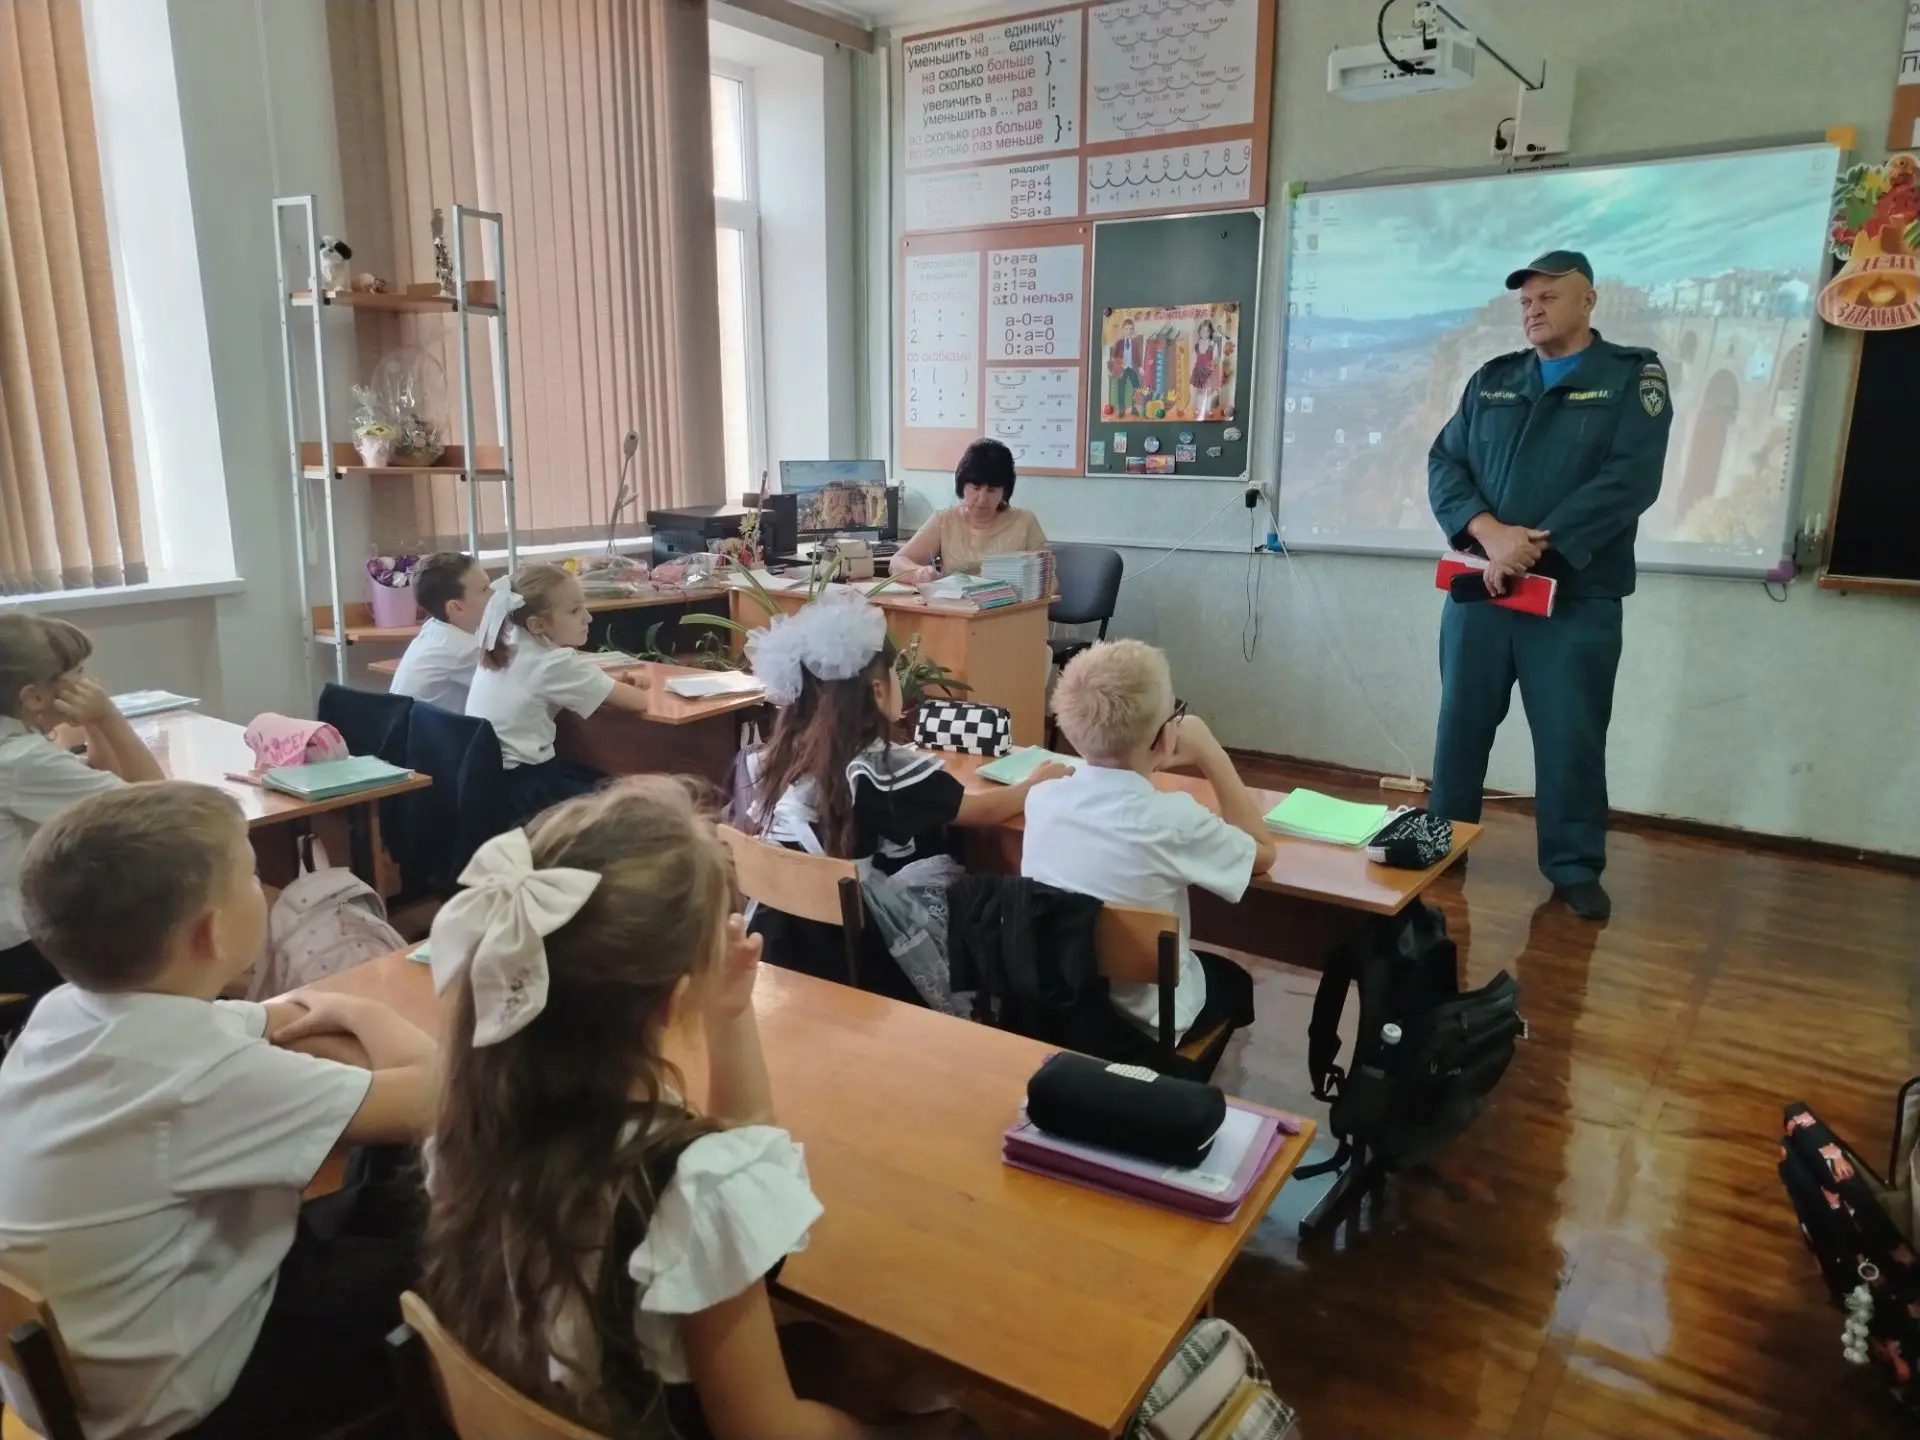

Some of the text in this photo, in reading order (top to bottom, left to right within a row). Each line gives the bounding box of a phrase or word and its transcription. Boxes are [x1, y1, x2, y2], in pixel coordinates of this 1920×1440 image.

[908, 36, 967, 57] увеличить
[970, 32, 984, 45] на
[908, 51, 971, 73] уменьшить
[975, 45, 989, 58] на
[922, 54, 1034, 83] на сколько больше
[922, 67, 1036, 96] на сколько меньше
[923, 95, 982, 114] увеличить
[985, 94, 992, 103] в
[1012, 86, 1033, 103] раз
[923, 108, 987, 129] уменьшить
[990, 106, 997, 116] в
[1017, 100, 1038, 116] раз
[924, 128, 970, 145] сколько
[972, 125, 993, 141] раз
[995, 118, 1043, 135] больше
[972, 140, 993, 156] раз
[995, 133, 1044, 150] меньше
[1009, 163, 1050, 174] квадрат
[1089, 146, 1250, 177] 1 2 3 4 5 6 7 8 9
[1022, 292, 1073, 304] нельзя
